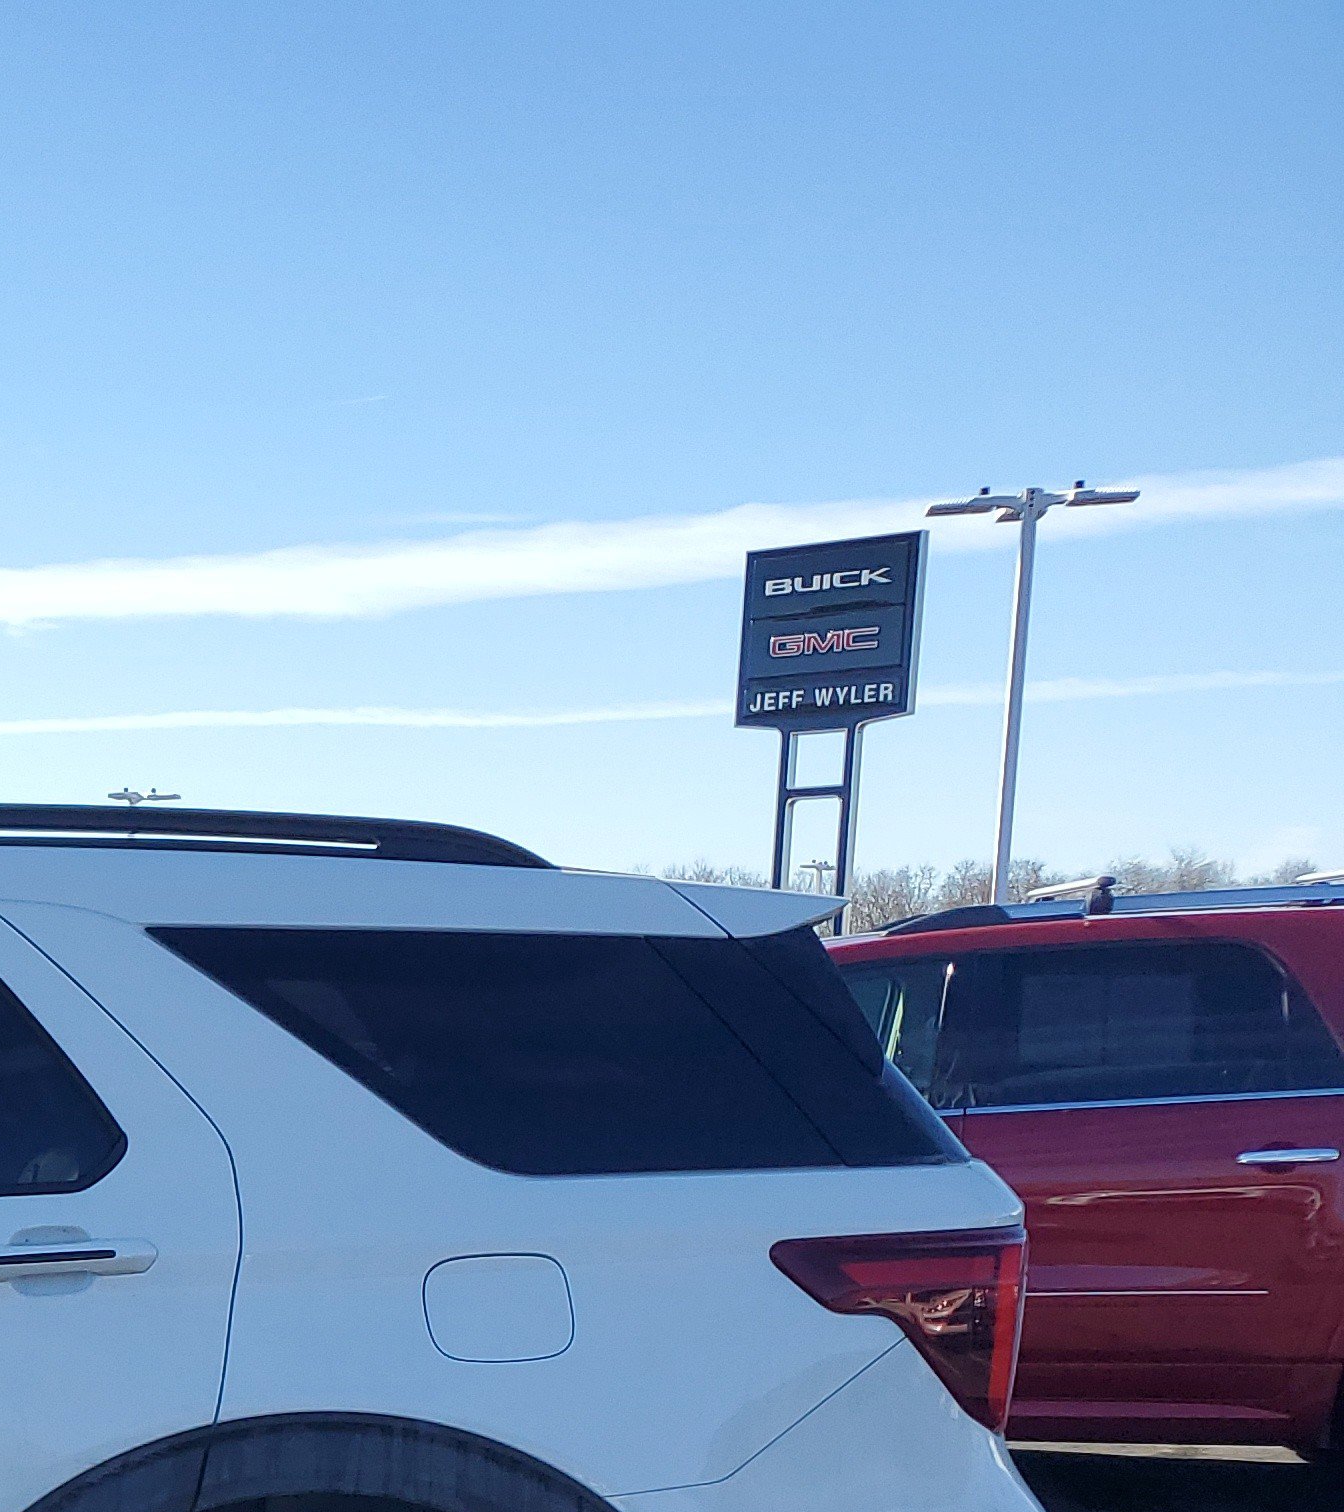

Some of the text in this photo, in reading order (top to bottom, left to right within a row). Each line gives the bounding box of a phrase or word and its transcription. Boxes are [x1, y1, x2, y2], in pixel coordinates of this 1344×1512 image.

[765, 567, 893, 597] BUICK
[769, 626, 880, 658] GMC
[749, 683, 894, 712] JEFF WYLER
